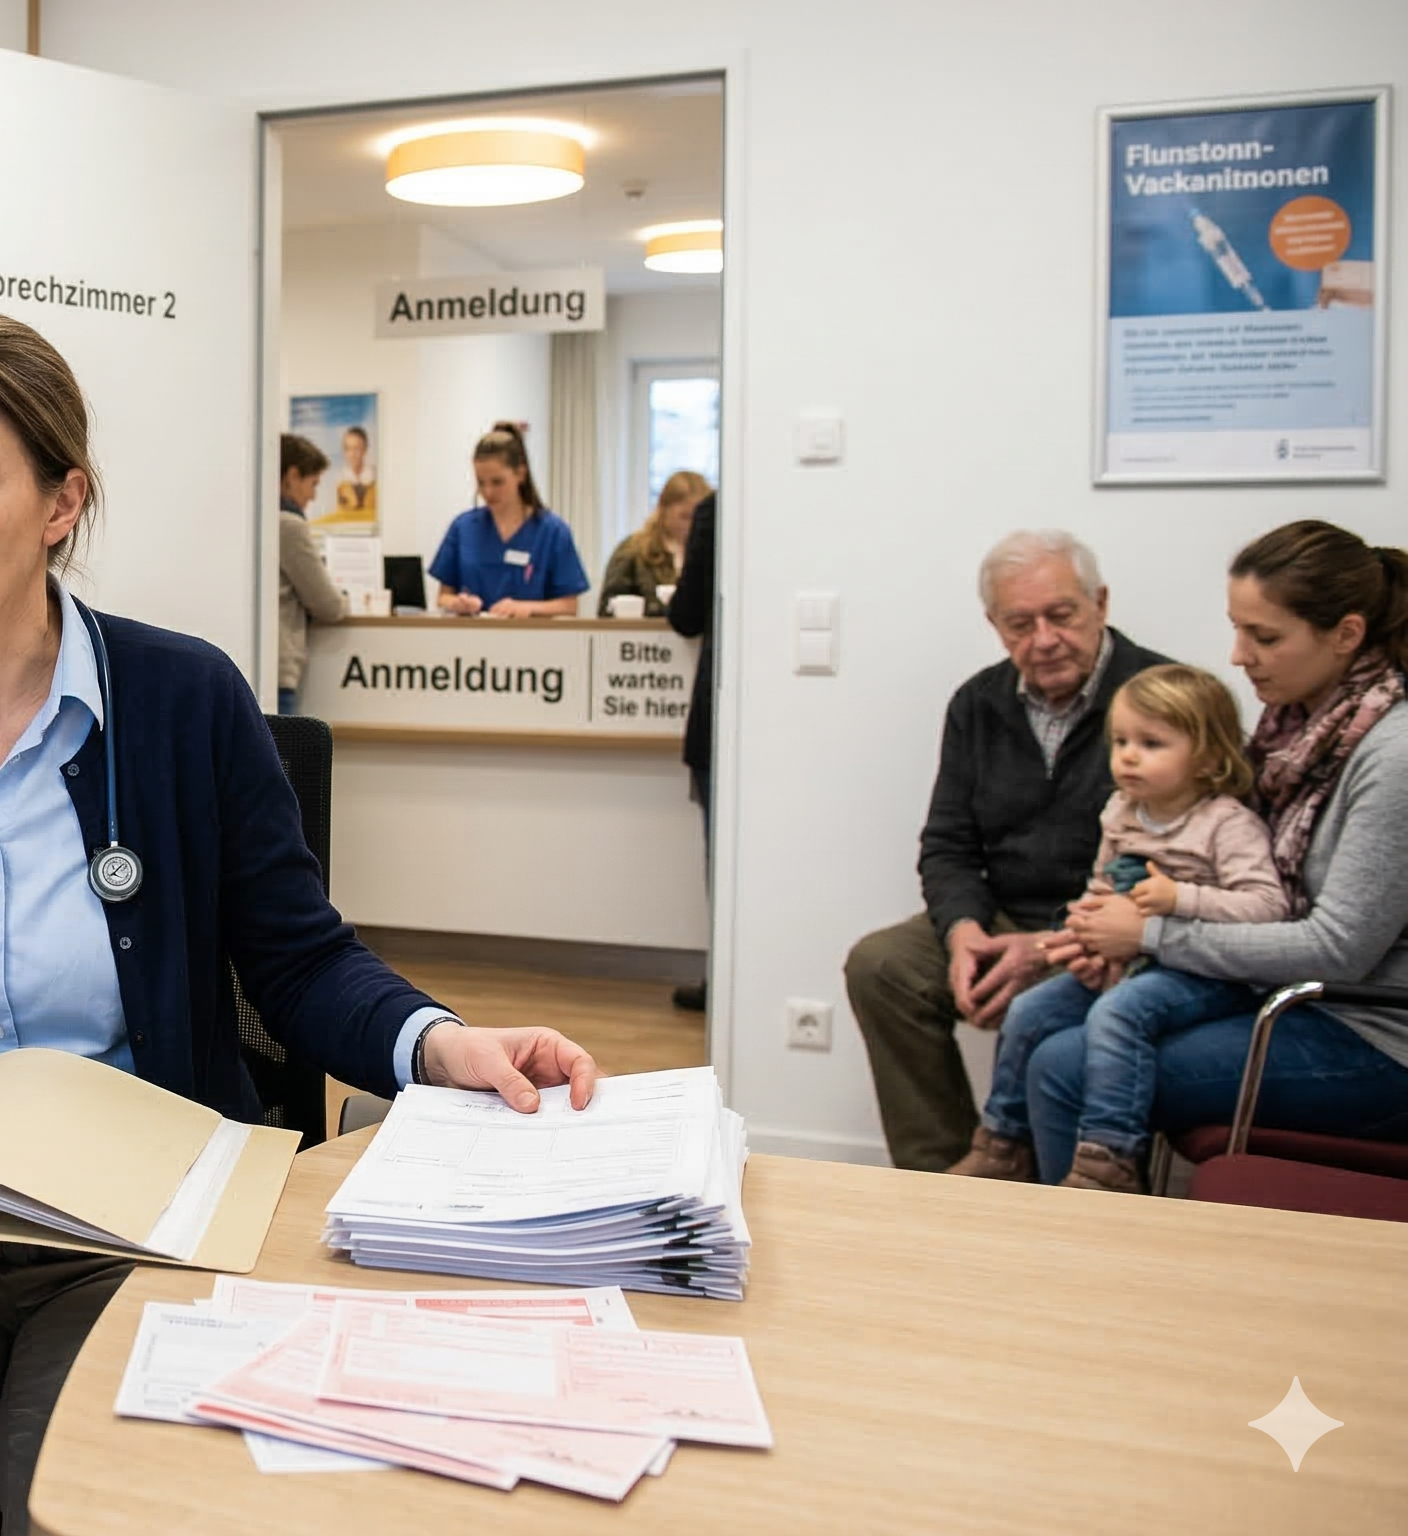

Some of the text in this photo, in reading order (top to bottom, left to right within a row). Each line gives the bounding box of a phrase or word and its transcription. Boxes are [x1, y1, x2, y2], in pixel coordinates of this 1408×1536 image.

[163, 291, 176, 319] 2
[389, 287, 585, 322] Anmeldung
[620, 641, 672, 663] Bitte
[341, 656, 564, 703] Anmeldung
[608, 671, 684, 690] warten
[603, 695, 689, 718] Sie hier
